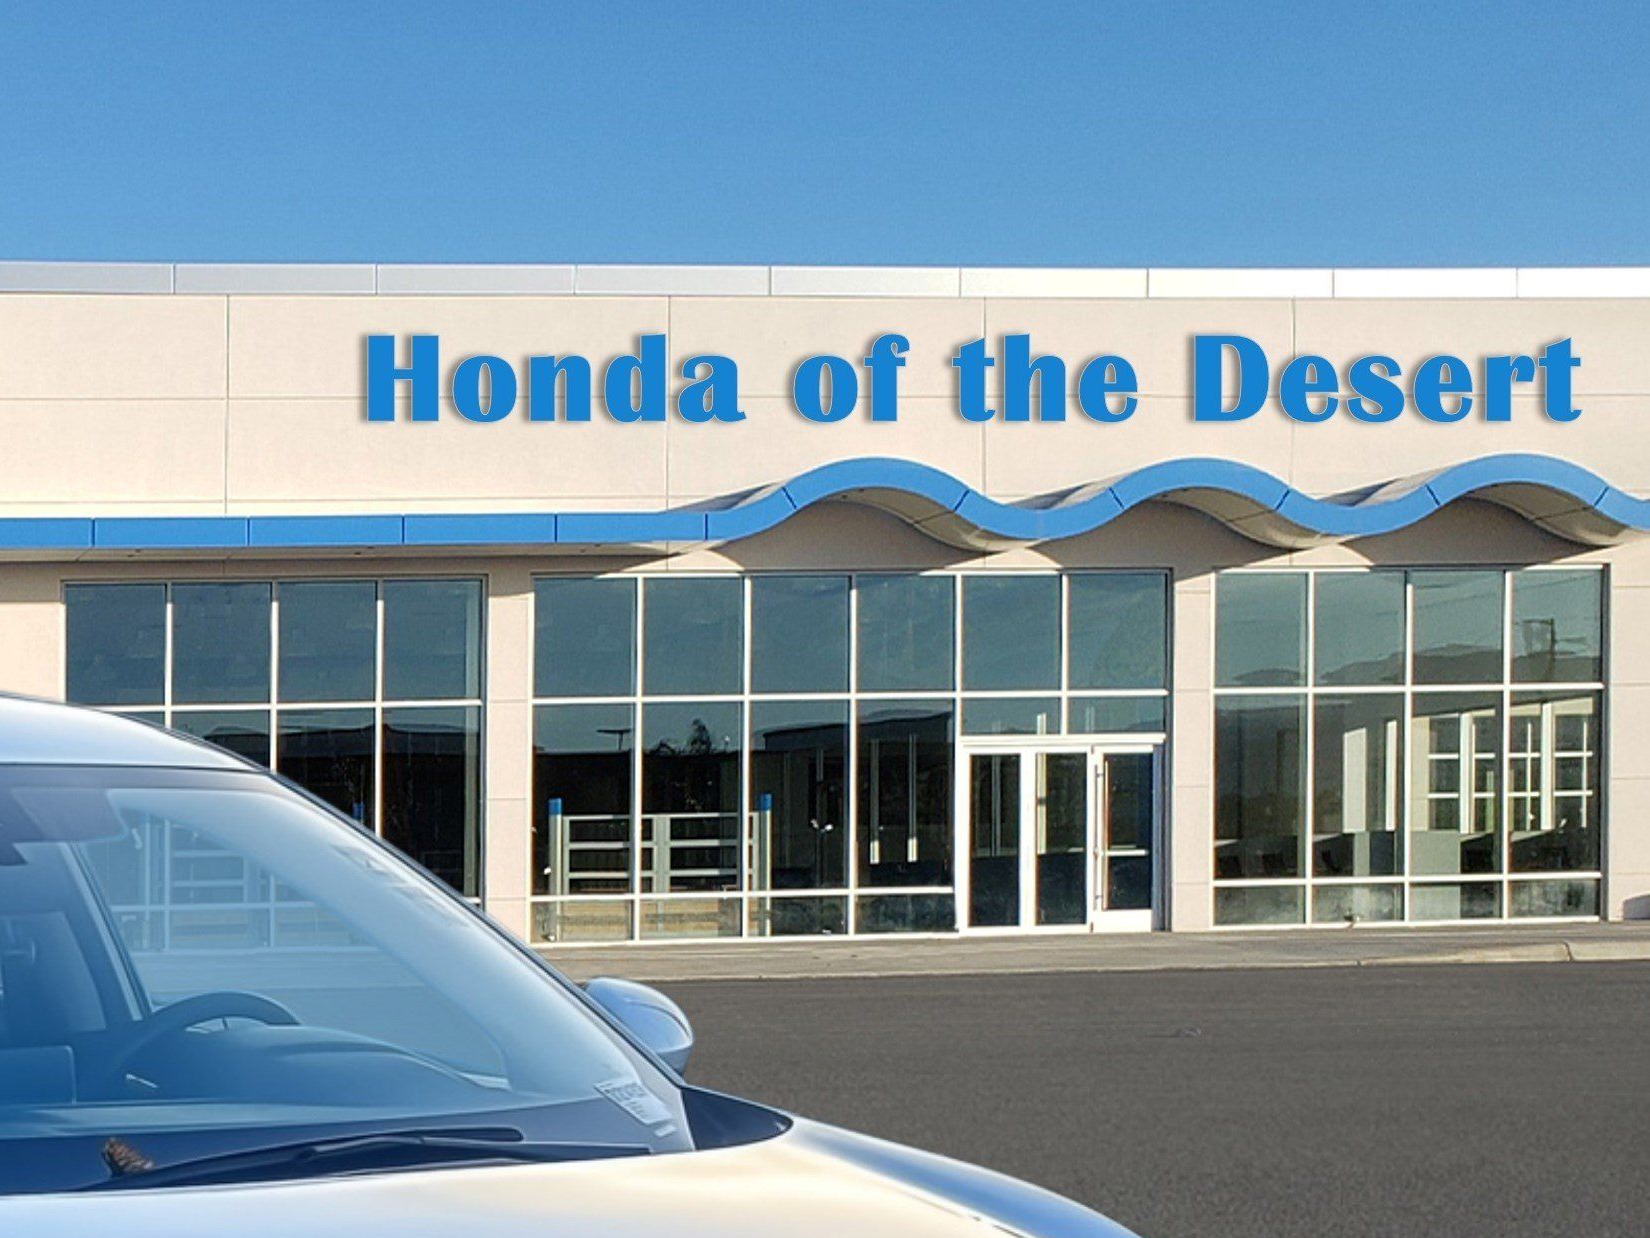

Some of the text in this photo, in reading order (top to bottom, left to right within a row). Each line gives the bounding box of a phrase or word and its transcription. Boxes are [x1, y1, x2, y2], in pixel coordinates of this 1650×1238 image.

[366, 333, 1583, 423] Honda of the Desert
